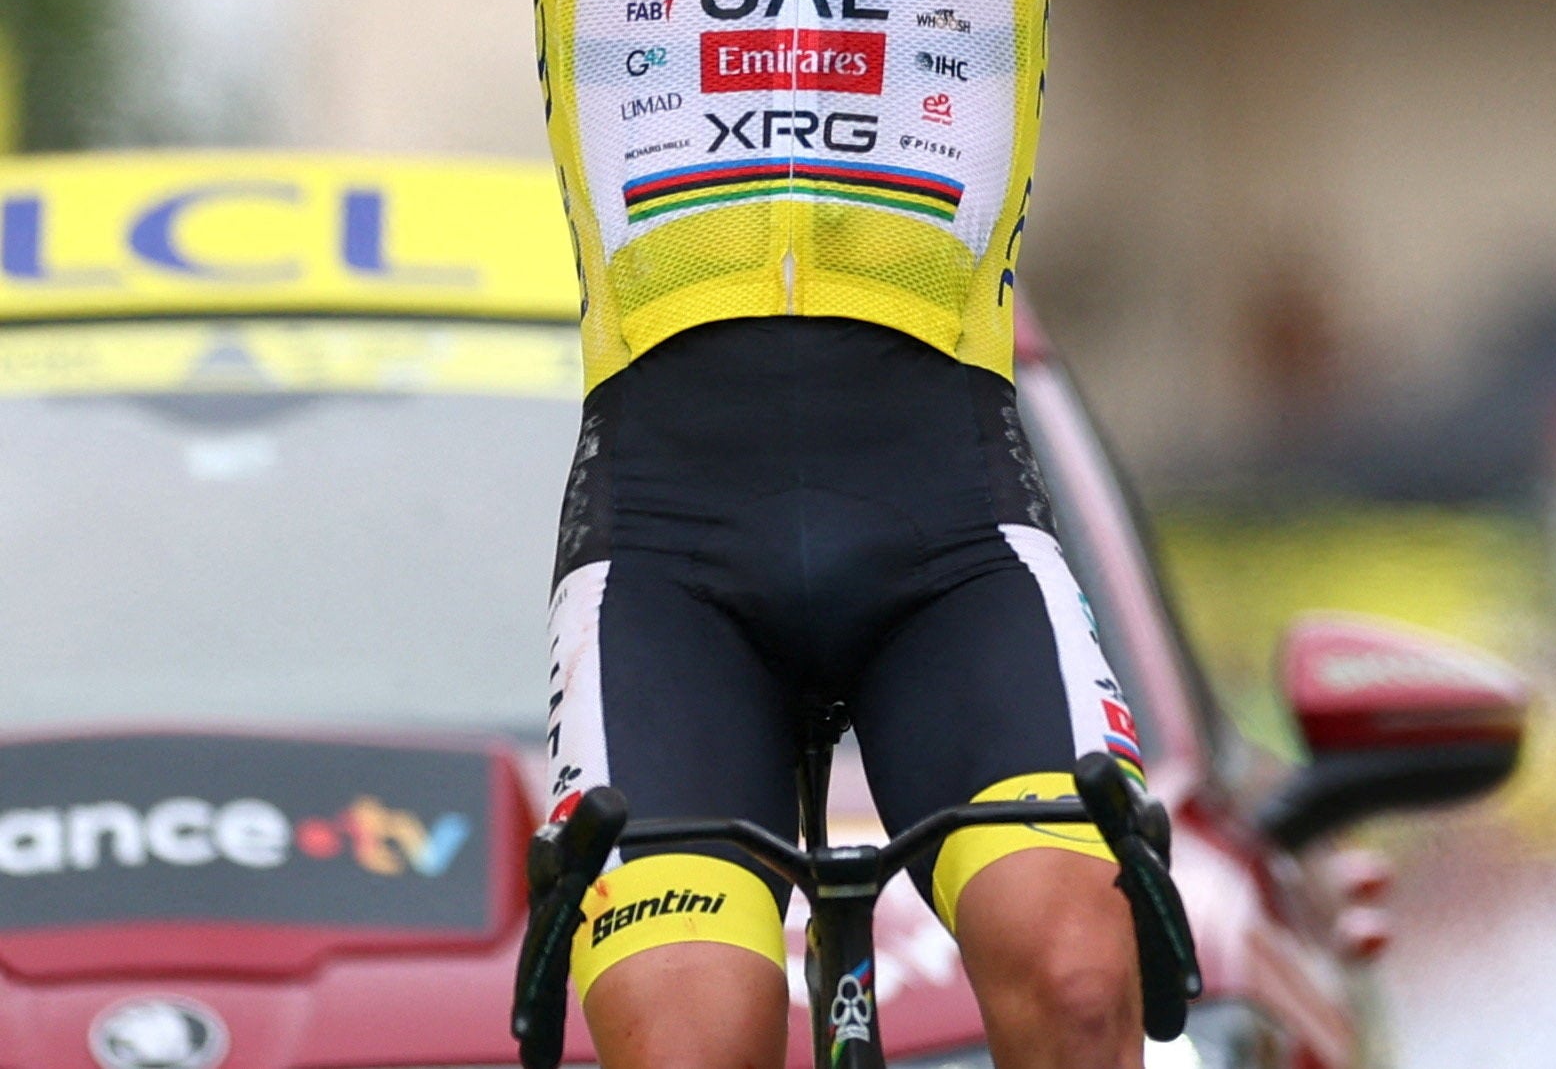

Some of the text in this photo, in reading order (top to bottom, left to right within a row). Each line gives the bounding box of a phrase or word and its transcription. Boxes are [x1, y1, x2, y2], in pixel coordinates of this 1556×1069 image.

[626, 47, 667, 76] G42
[718, 45, 867, 76] Emirates
[935, 56, 968, 81] IHC
[704, 110, 878, 153] XRG
[915, 140, 962, 161] PISSEI
[3, 184, 478, 286] LCL
[591, 888, 726, 949] Santini
